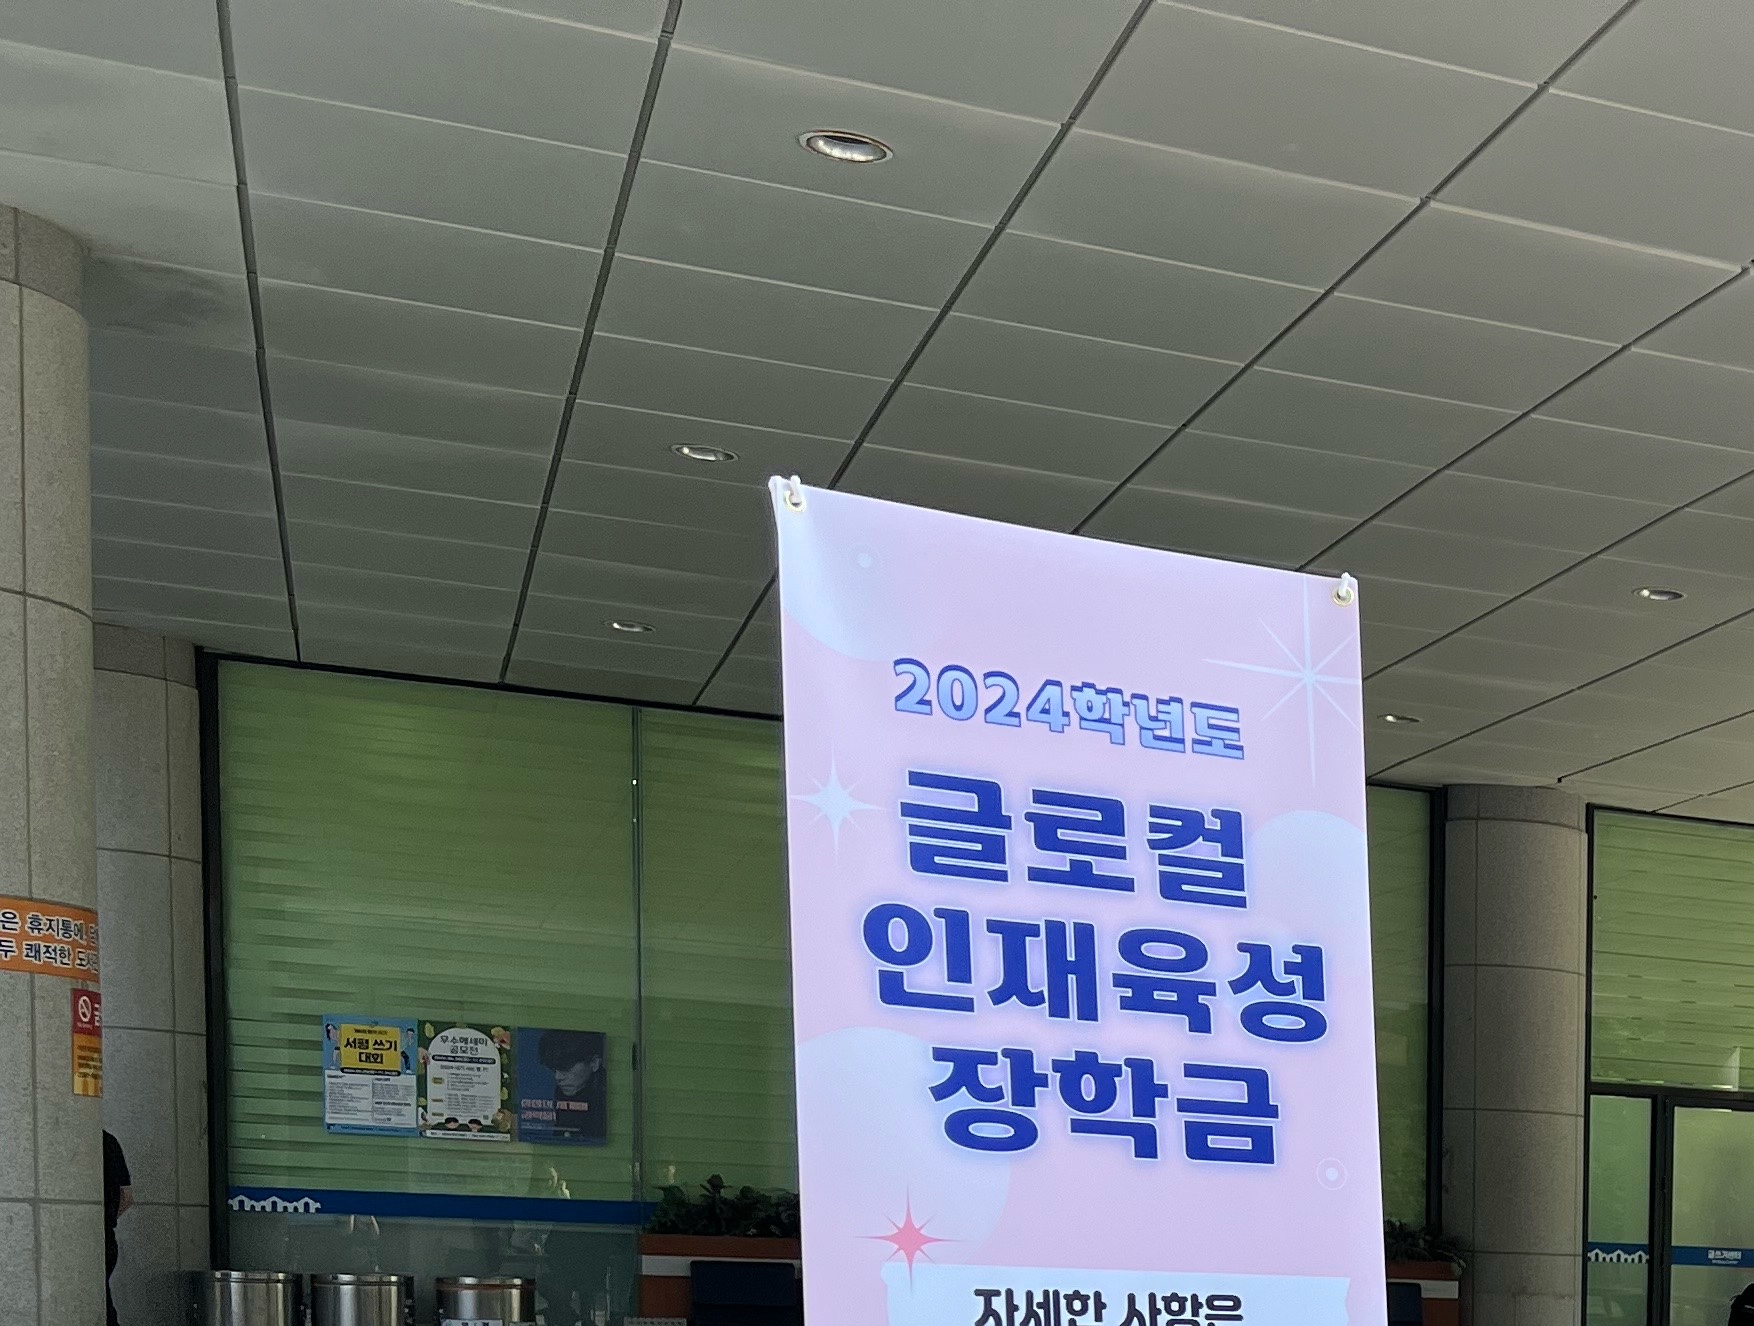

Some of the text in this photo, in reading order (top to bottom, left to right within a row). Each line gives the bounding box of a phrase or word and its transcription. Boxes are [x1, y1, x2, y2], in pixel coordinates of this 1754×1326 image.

[892, 657, 1245, 760] 2024학년도
[898, 769, 1249, 910] 글로컬
[24, 944, 71, 966] 쾌적한
[28, 914, 84, 940] 휴지통에
[861, 902, 1328, 1043] 인재육성
[928, 1046, 1280, 1165] 장학금
